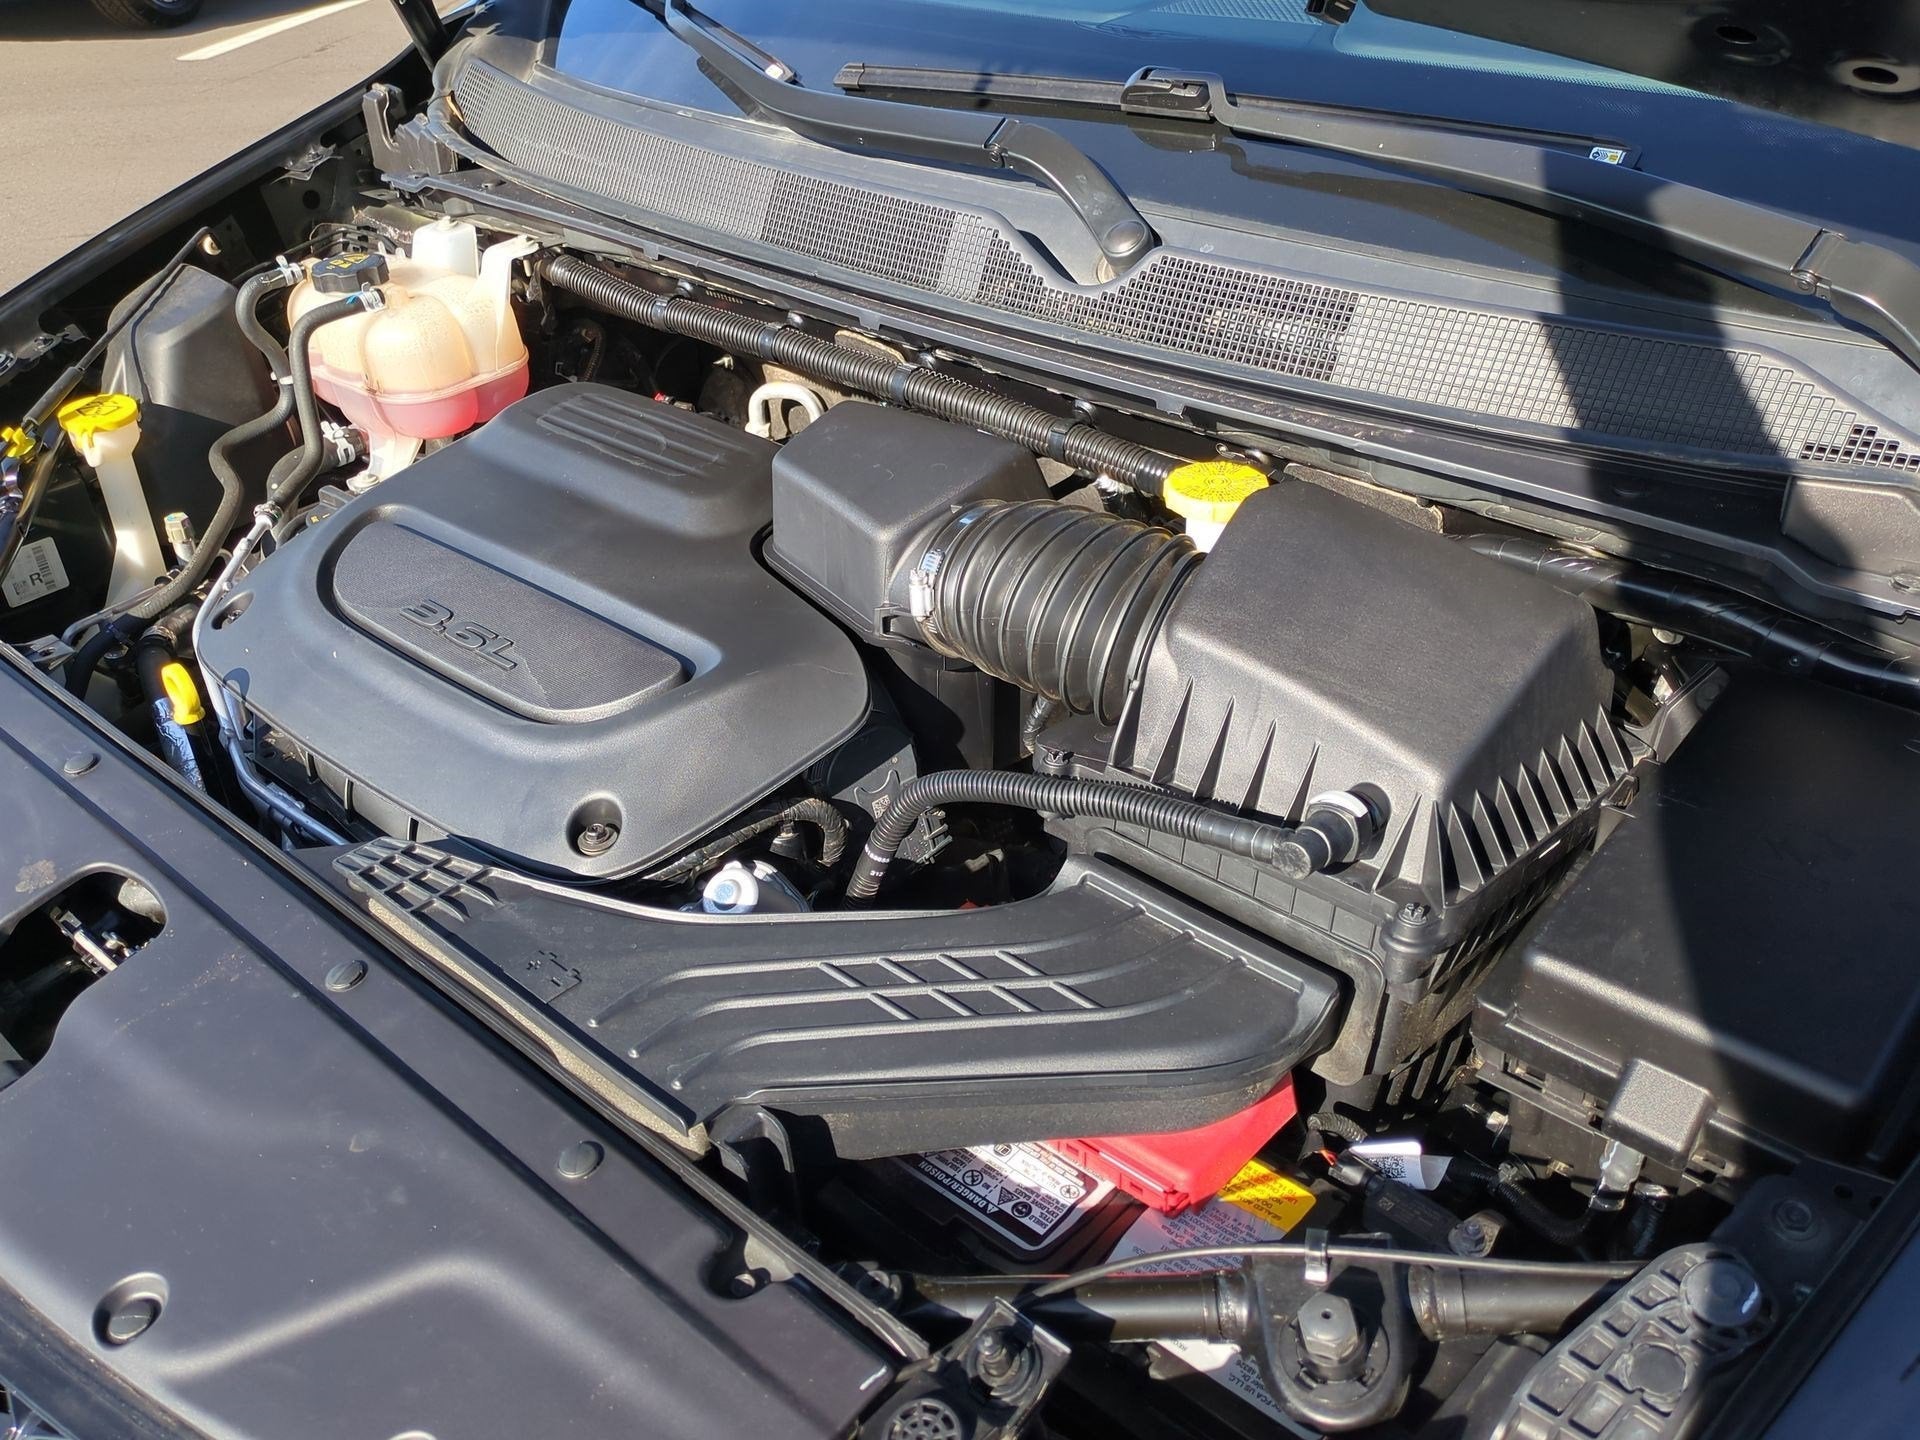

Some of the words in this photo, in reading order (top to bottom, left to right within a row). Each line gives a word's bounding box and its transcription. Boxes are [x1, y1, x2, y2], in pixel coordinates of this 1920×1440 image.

[29, 572, 43, 587] R
[400, 600, 517, 671] 3.6L
[917, 1159, 986, 1208] DANGER/POISON
[1027, 1214, 1048, 1229] SHIELD
[1255, 1391, 1272, 1405] FCA
